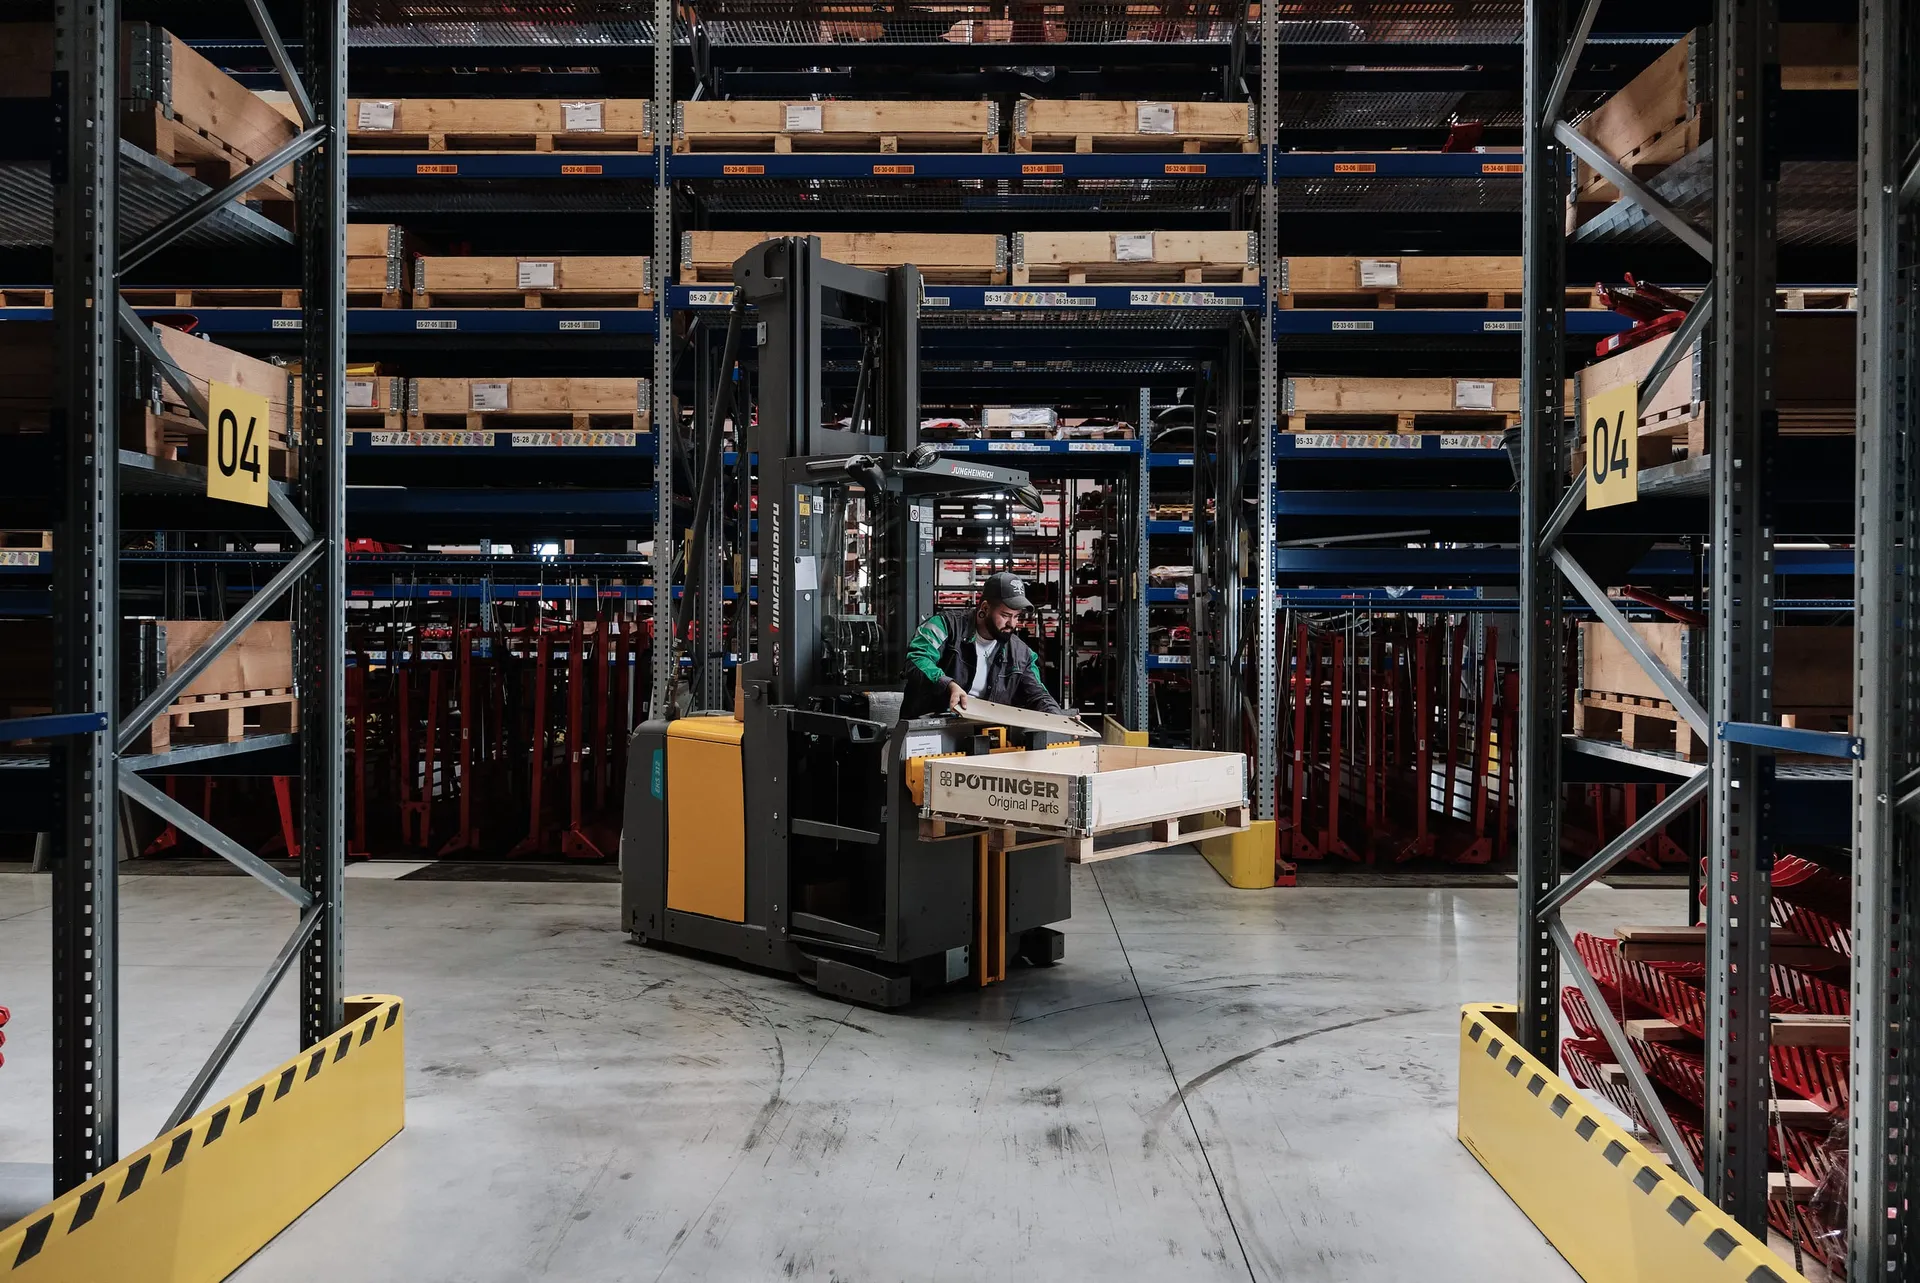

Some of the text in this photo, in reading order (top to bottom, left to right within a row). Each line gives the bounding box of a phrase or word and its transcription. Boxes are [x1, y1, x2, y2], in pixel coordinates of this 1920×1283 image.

[690, 294, 707, 302] 05-29
[986, 294, 1003, 302] 05-31
[1131, 294, 1148, 302] 05-32
[513, 436, 530, 444] 05-28
[1296, 437, 1313, 445] 05-33
[1441, 438, 1458, 446] 05-34
[218, 408, 260, 482] 04
[1593, 410, 1628, 484] 04
[951, 464, 994, 479] JUNGHEINRICH
[988, 794, 1059, 814] Original Parts
